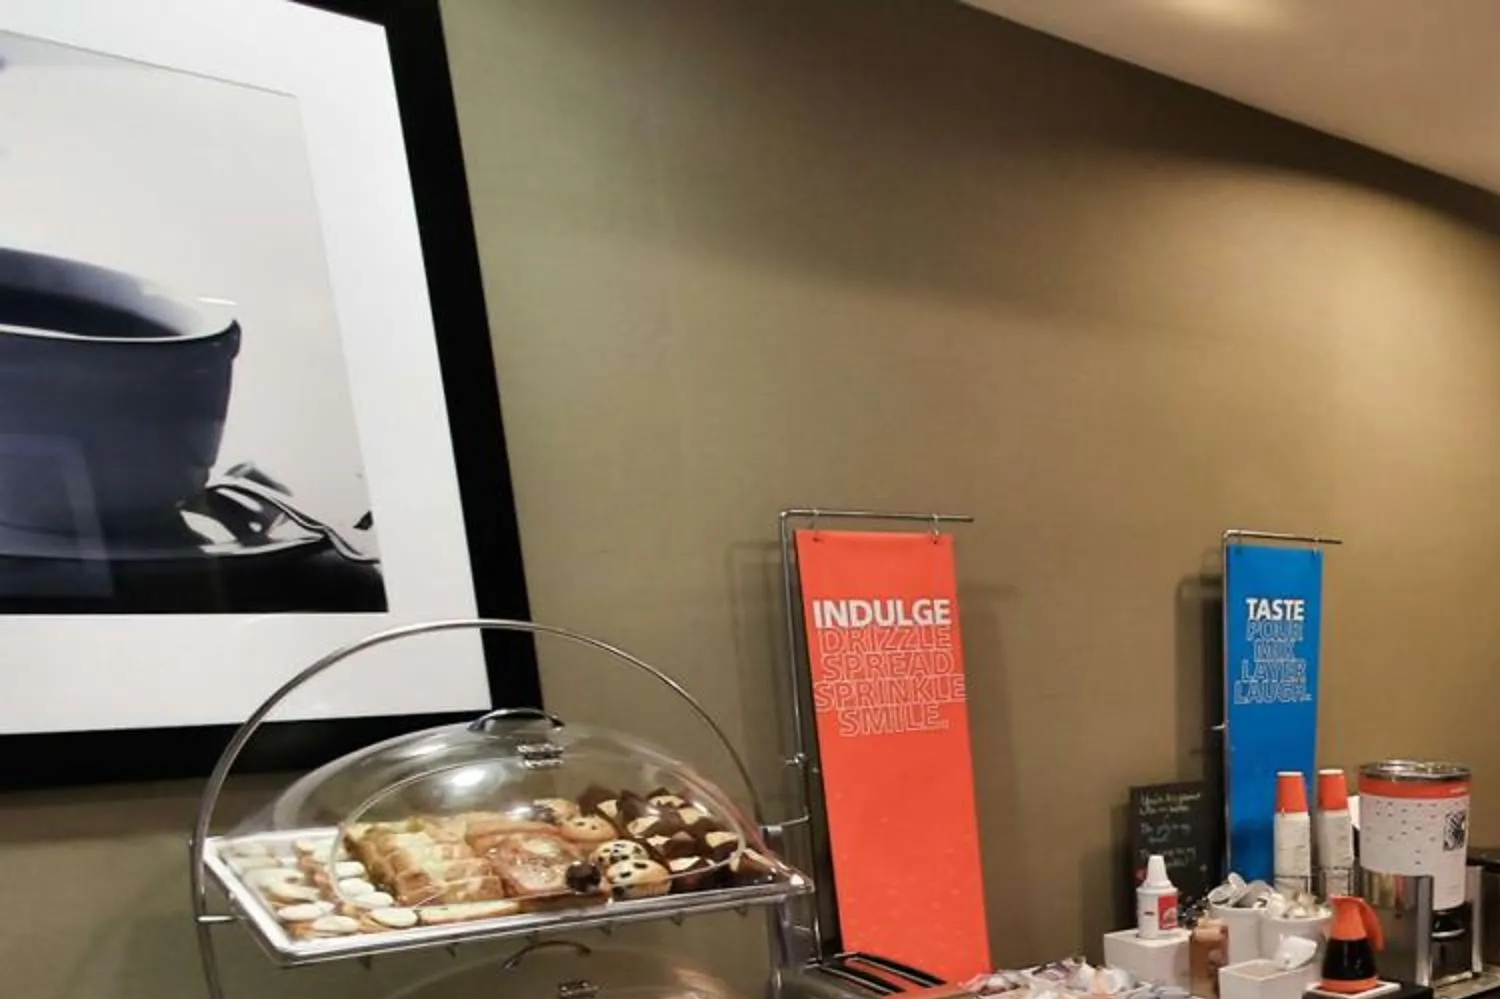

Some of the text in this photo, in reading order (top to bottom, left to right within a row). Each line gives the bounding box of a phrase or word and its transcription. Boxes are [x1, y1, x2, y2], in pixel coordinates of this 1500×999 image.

[812, 599, 952, 628] INDULGE
[1245, 598, 1304, 620] TASTE
[818, 625, 952, 655] DRIZZLE
[820, 650, 956, 682] SPREAD
[813, 673, 968, 714] SPRINKLE
[837, 702, 950, 737] SMILE.
